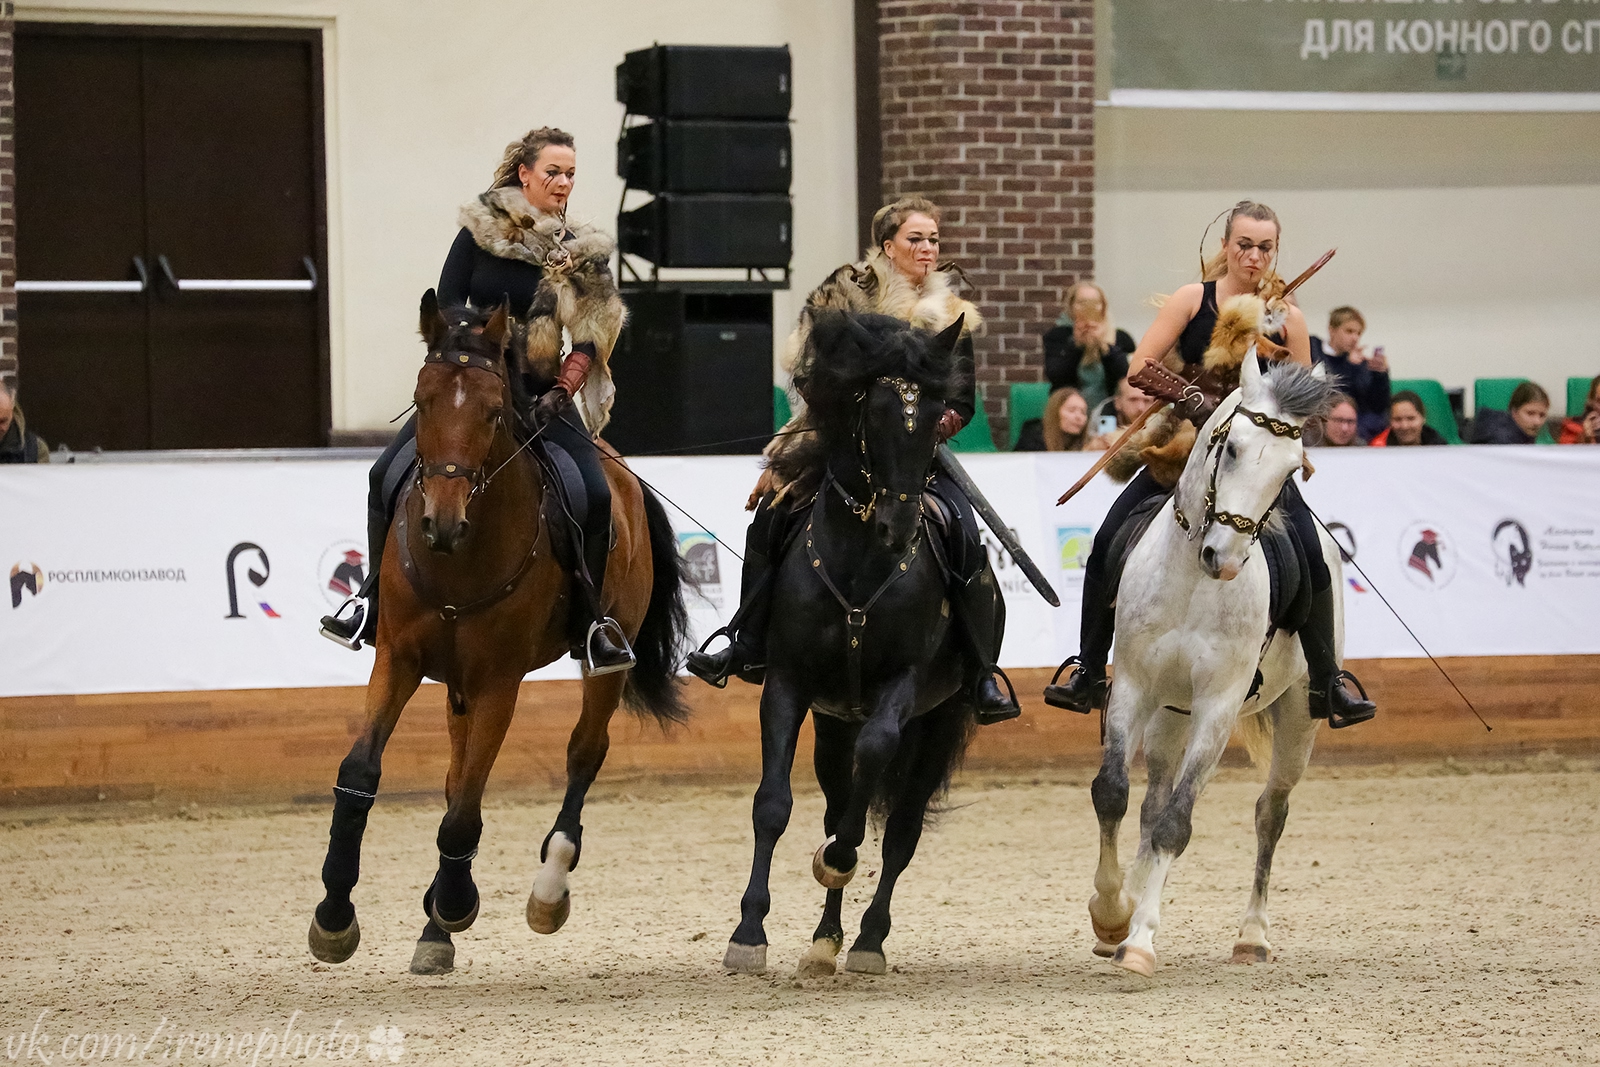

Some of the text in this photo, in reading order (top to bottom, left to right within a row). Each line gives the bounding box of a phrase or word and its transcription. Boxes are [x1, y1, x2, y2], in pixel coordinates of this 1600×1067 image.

[1301, 19, 1375, 60] ДЛЯ
[1386, 19, 1552, 53] КОННОГО
[48, 568, 187, 583] РОСПЛЕМКОНЗАВОД
